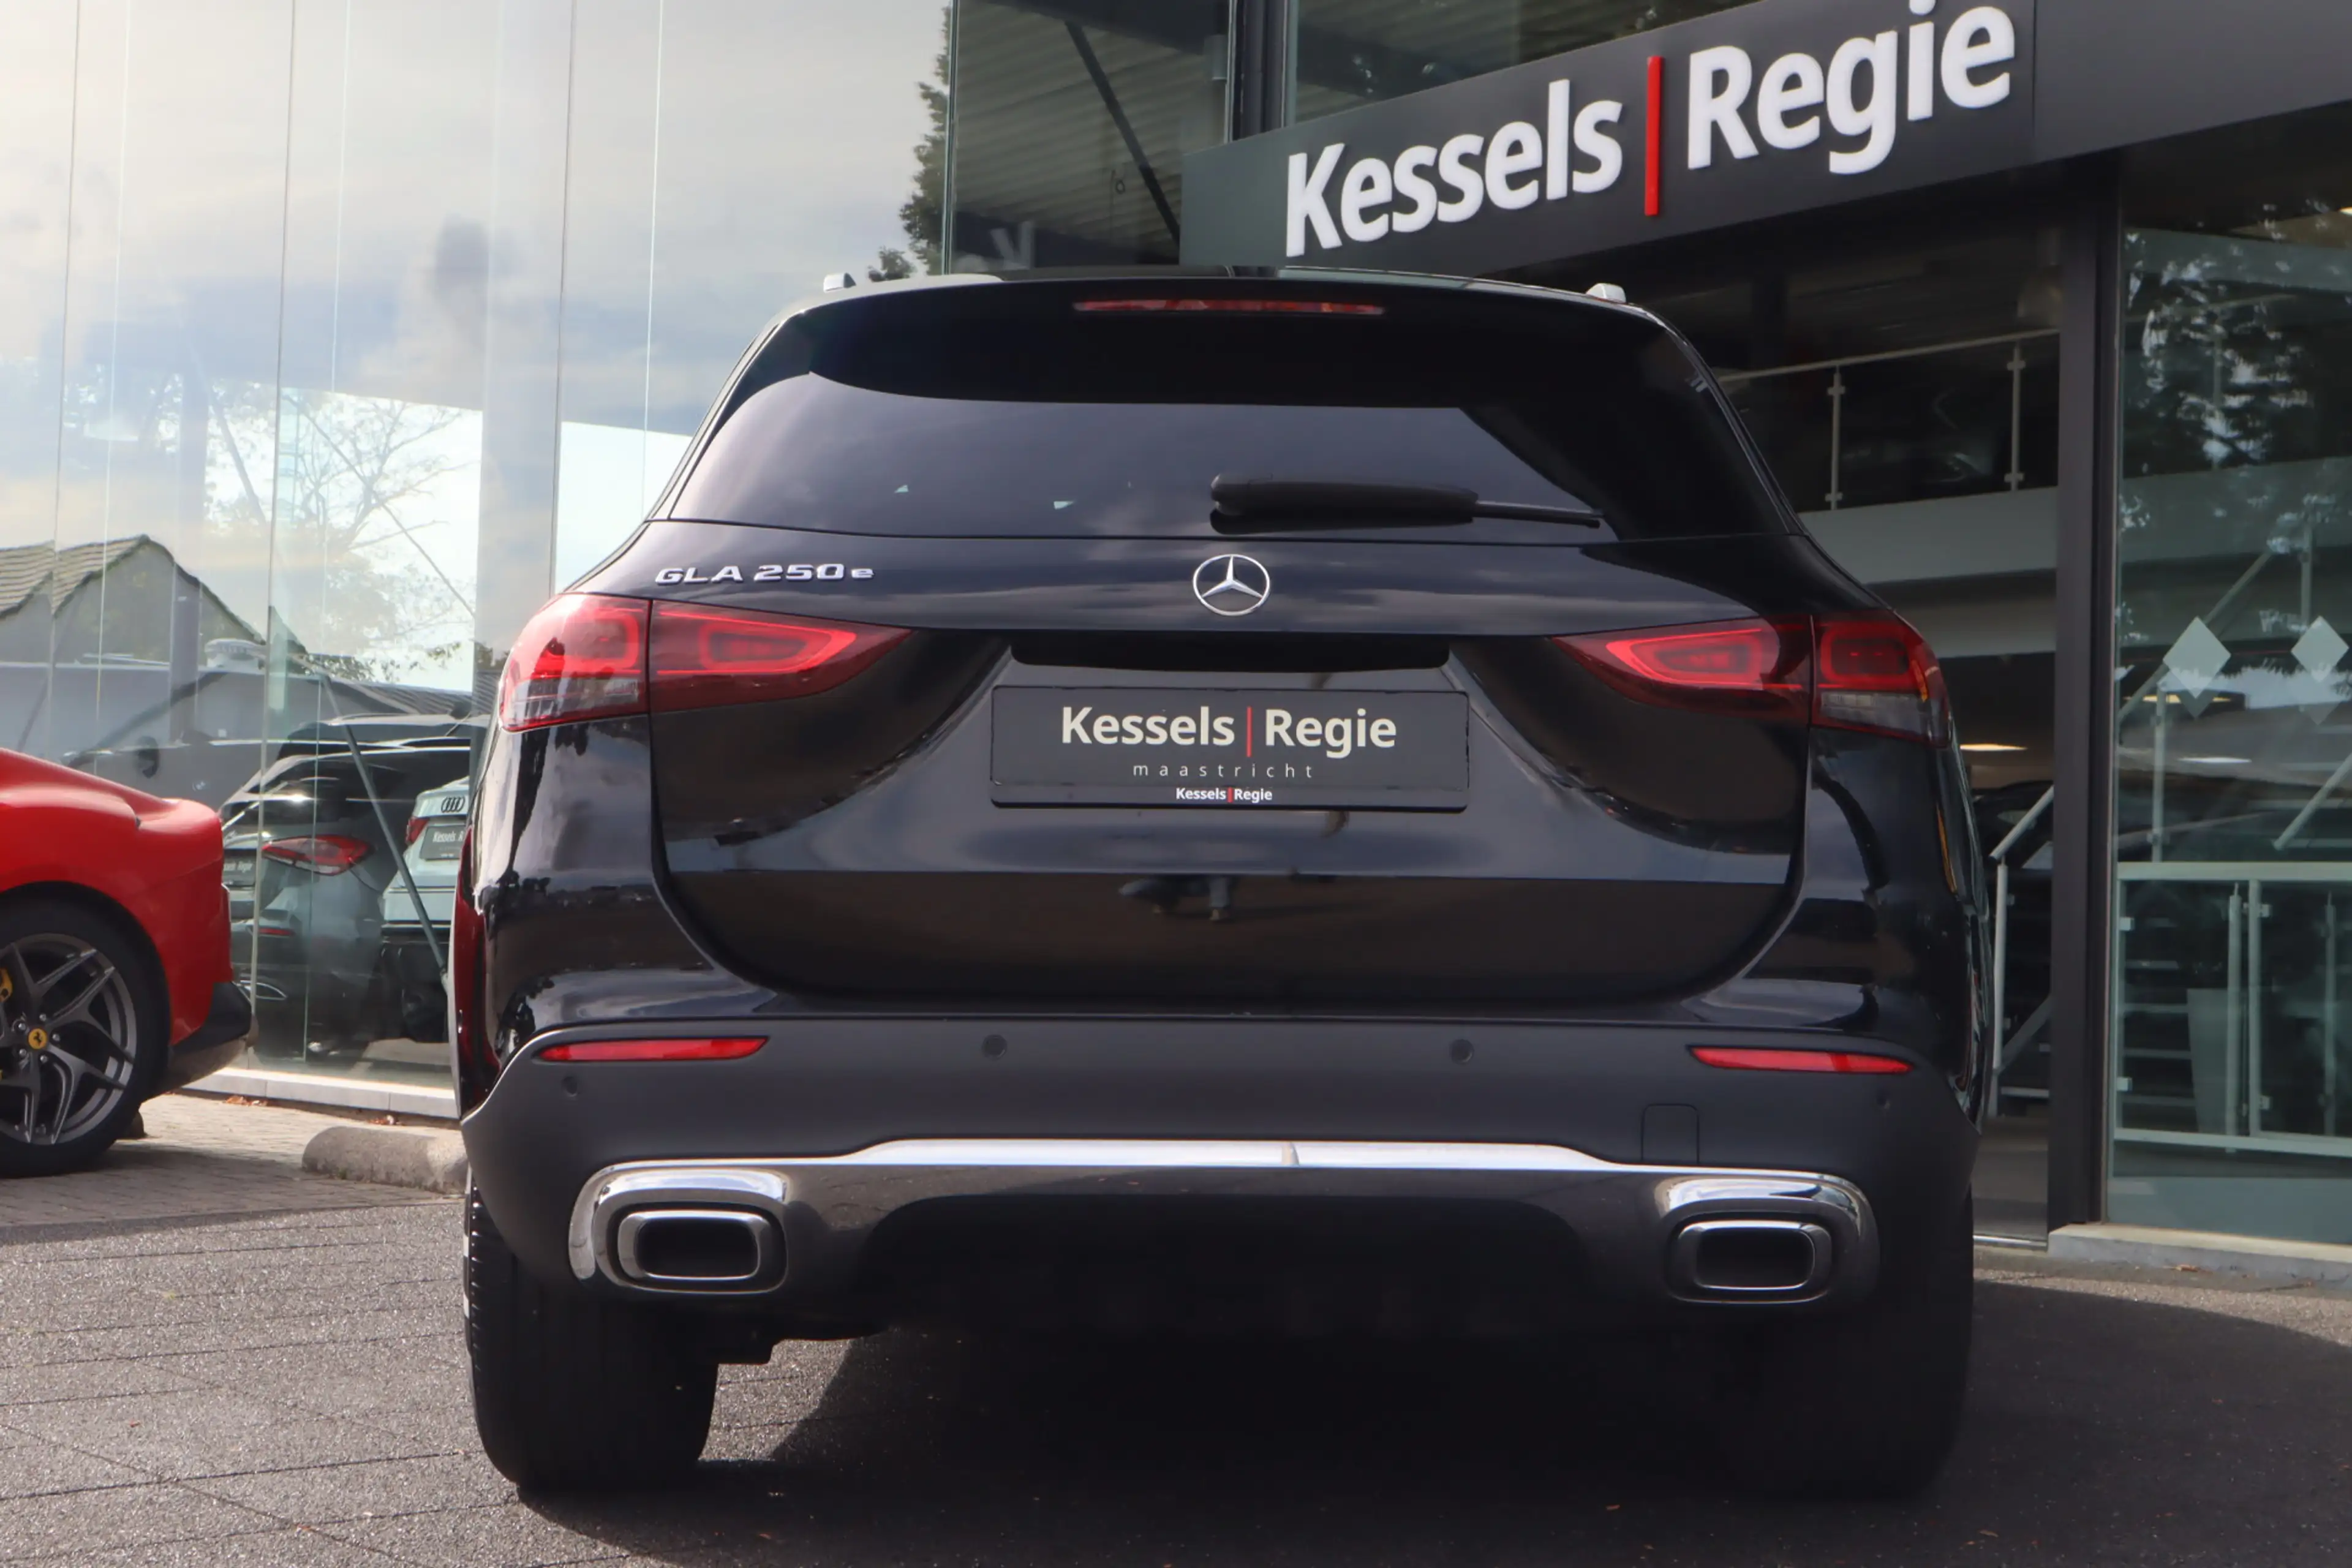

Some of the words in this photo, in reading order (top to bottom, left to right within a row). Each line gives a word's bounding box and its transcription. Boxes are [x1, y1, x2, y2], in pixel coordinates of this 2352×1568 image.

[1286, 78, 1623, 257] Kessels
[1688, 0, 2015, 175] Regie
[655, 565, 744, 585] GLA
[1062, 706, 1235, 746] Kessels
[1265, 707, 1397, 759] Regie
[1133, 763, 1313, 778] maastricht
[1175, 787, 1227, 800] Kessels
[1234, 788, 1273, 803] Regie
